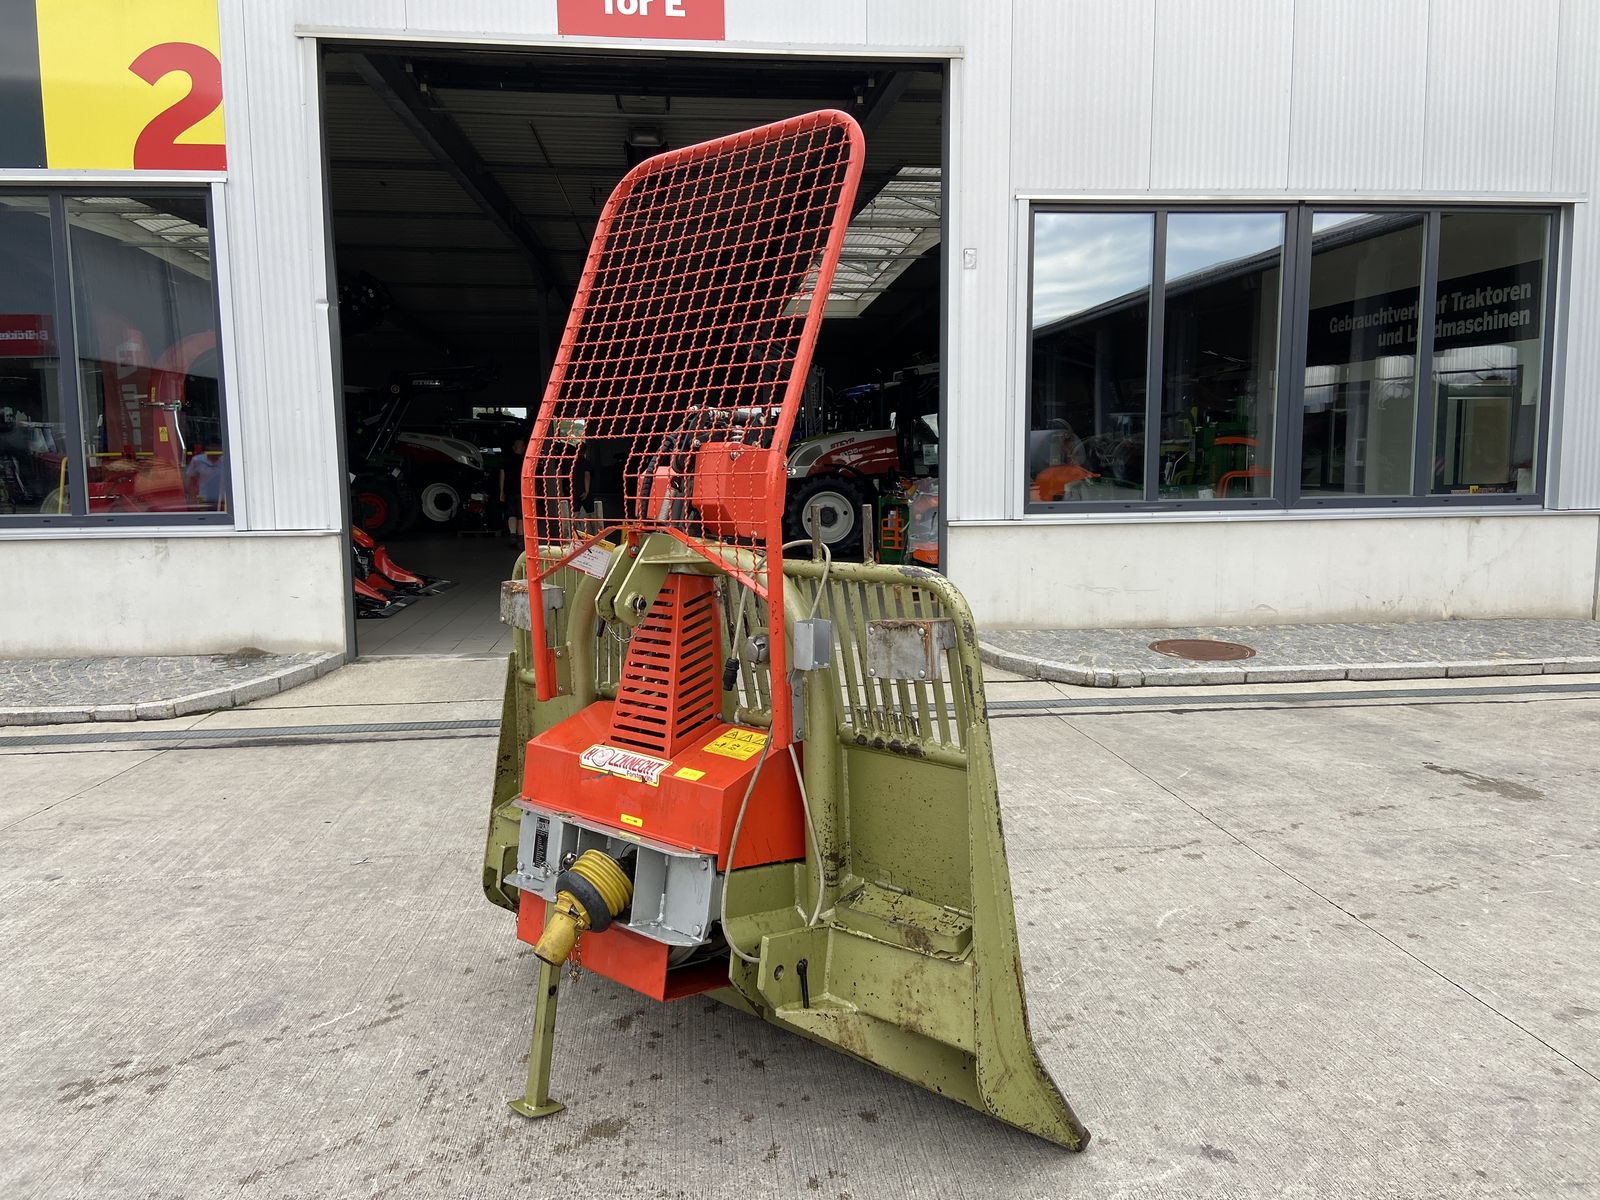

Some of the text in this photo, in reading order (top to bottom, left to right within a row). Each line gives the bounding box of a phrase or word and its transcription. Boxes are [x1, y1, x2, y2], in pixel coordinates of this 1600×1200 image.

[128, 42, 227, 171] 2
[1329, 282, 1532, 334] Gebrauchtverf Traktoren
[1377, 308, 1530, 347] und Ldmaschinen
[830, 437, 855, 449] STEYR
